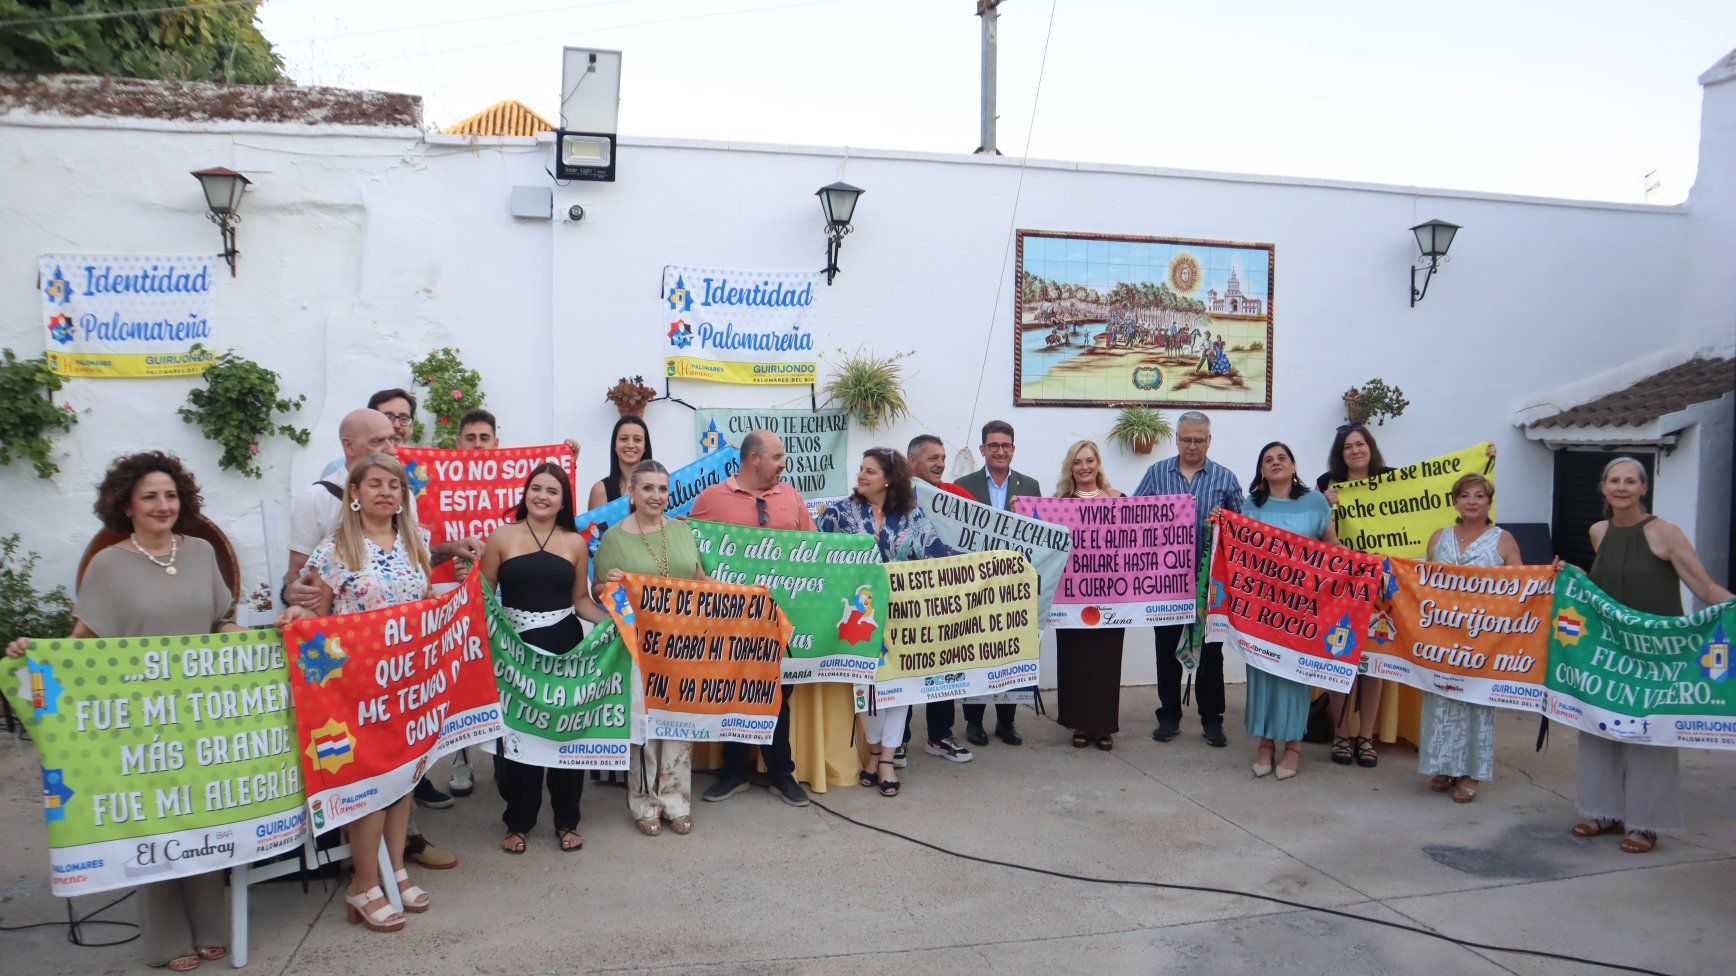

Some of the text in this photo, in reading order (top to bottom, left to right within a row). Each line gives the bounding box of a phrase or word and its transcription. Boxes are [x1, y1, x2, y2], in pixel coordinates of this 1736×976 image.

[82, 264, 211, 297] Identidad
[701, 277, 813, 308] Identidad
[80, 311, 211, 342] Palomareña
[698, 321, 813, 352] Palomareña
[753, 364, 815, 374] GUIRIJONDO
[728, 415, 798, 435] CUANTO TE
[434, 457, 541, 481] YO NO SOY
[724, 457, 740, 478] es
[796, 454, 834, 473] SALGA
[1400, 464, 1417, 480] se
[439, 488, 492, 512] ESTA
[1378, 489, 1442, 516] cuando
[932, 492, 991, 530] CUANTO
[993, 512, 1014, 537] TE
[1078, 502, 1176, 526] VIVIRÉ MIENTRAS
[444, 520, 466, 542] NI
[957, 526, 981, 552] DE
[1090, 525, 1195, 550] EL ALMA ME SUENE
[1356, 526, 1421, 552] dormí...
[718, 532, 738, 558] lo
[743, 537, 784, 562] alto
[788, 540, 820, 564] del
[1072, 549, 1192, 574] BAILARÉ HASTA QUE
[1268, 536, 1296, 560] EN
[1298, 545, 1322, 570] MI
[710, 562, 827, 600] dice piropos
[890, 554, 1025, 593] EN ESTE MUNDO SEÑORES
[1064, 572, 1190, 598] EL CUERPO AGUANTE
[1228, 544, 1370, 603] TAMBOR Y UNA
[1414, 562, 1520, 596] Vámonos
[640, 585, 766, 620] DEJE DE PENSAR EN
[888, 582, 1032, 620] TANTO TIENES TANTO VALES
[1231, 570, 1320, 618] ESTAMPA
[1102, 612, 1134, 626] Luna
[1146, 604, 1194, 614] GUIRIJONDO
[1419, 600, 1542, 638] Guirijondo
[384, 616, 412, 647] AL
[890, 608, 1028, 646] Y EN EL TRIBUNAL DE DIOS
[1257, 606, 1319, 640] ROCÍO
[642, 629, 663, 656] SE
[664, 630, 710, 662] ACABÓ
[708, 634, 726, 662] MI
[899, 637, 1020, 672] TOITOS SOMOS IGUALES
[1620, 630, 1704, 656] TIEMPO
[124, 642, 286, 682] ...SI GRANDE
[375, 651, 417, 689] QUE
[422, 640, 438, 671] TE
[532, 653, 603, 679] FUENTE,
[820, 658, 876, 670] GUIRIJONDO
[1298, 657, 1353, 676] GUIRIJONDO
[1412, 641, 1536, 674] cariño mio
[494, 658, 537, 700] COMO
[542, 683, 567, 708] LA
[572, 670, 624, 708] NÁCAR
[782, 668, 812, 680] MARÍA
[988, 664, 1038, 680] GUIRIJONDO
[1556, 662, 1640, 708] COMO UN
[358, 694, 392, 728] ME
[397, 668, 448, 715] TENGO
[646, 672, 780, 705] FIN, YA PUEDO DORMÍ
[926, 688, 967, 700] PALOMARES
[75, 698, 132, 732] FUE
[142, 695, 180, 727] MI
[515, 700, 627, 734] TUS DIENTES
[721, 718, 775, 730] GUIRIJONDO
[473, 729, 487, 738] DEL
[655, 726, 690, 739] GRAN
[692, 728, 710, 740] VÍA
[120, 724, 293, 776] MÁS GRANDE
[558, 744, 628, 755] GUIRIJONDO
[614, 758, 627, 766] RÍO
[92, 785, 194, 828] FUE MI
[342, 787, 378, 804] PALOMARES
[215, 829, 234, 840] BAR
[136, 842, 159, 866] El
